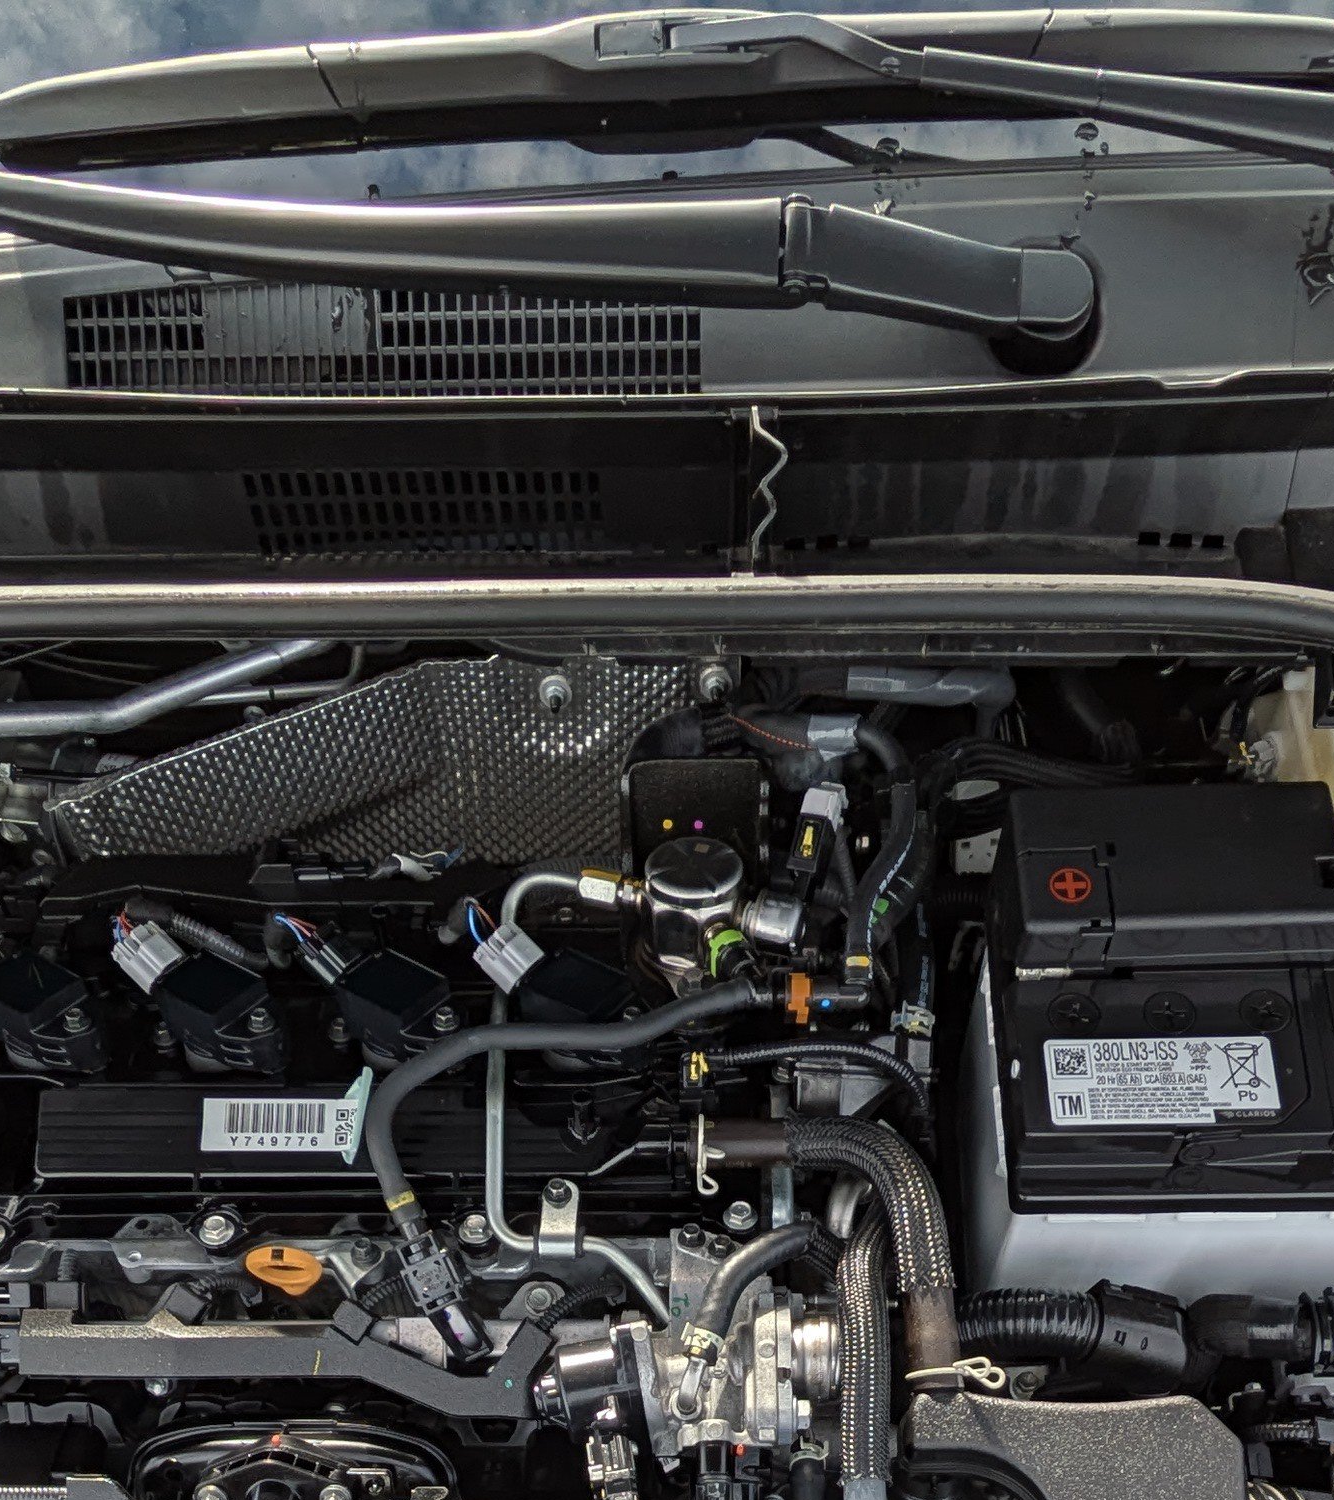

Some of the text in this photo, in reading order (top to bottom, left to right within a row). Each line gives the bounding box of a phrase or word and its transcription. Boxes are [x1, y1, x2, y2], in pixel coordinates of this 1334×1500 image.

[1093, 1041, 1178, 1061] 380LN3-ISS
[1096, 1075, 1106, 1085] 20
[1108, 1075, 1116, 1085] Hr
[1118, 1075, 1128, 1085] 65
[1130, 1075, 1140, 1085] Ah
[1144, 1074, 1160, 1085] CCA
[1178, 1074, 1184, 1084] A
[1187, 1073, 1207, 1086] (SAE)
[1238, 1090, 1258, 1102] Pb
[1058, 1095, 1083, 1116] TM
[1236, 1110, 1277, 1118] CLARIOS
[230, 1136, 319, 1147] Y749776
